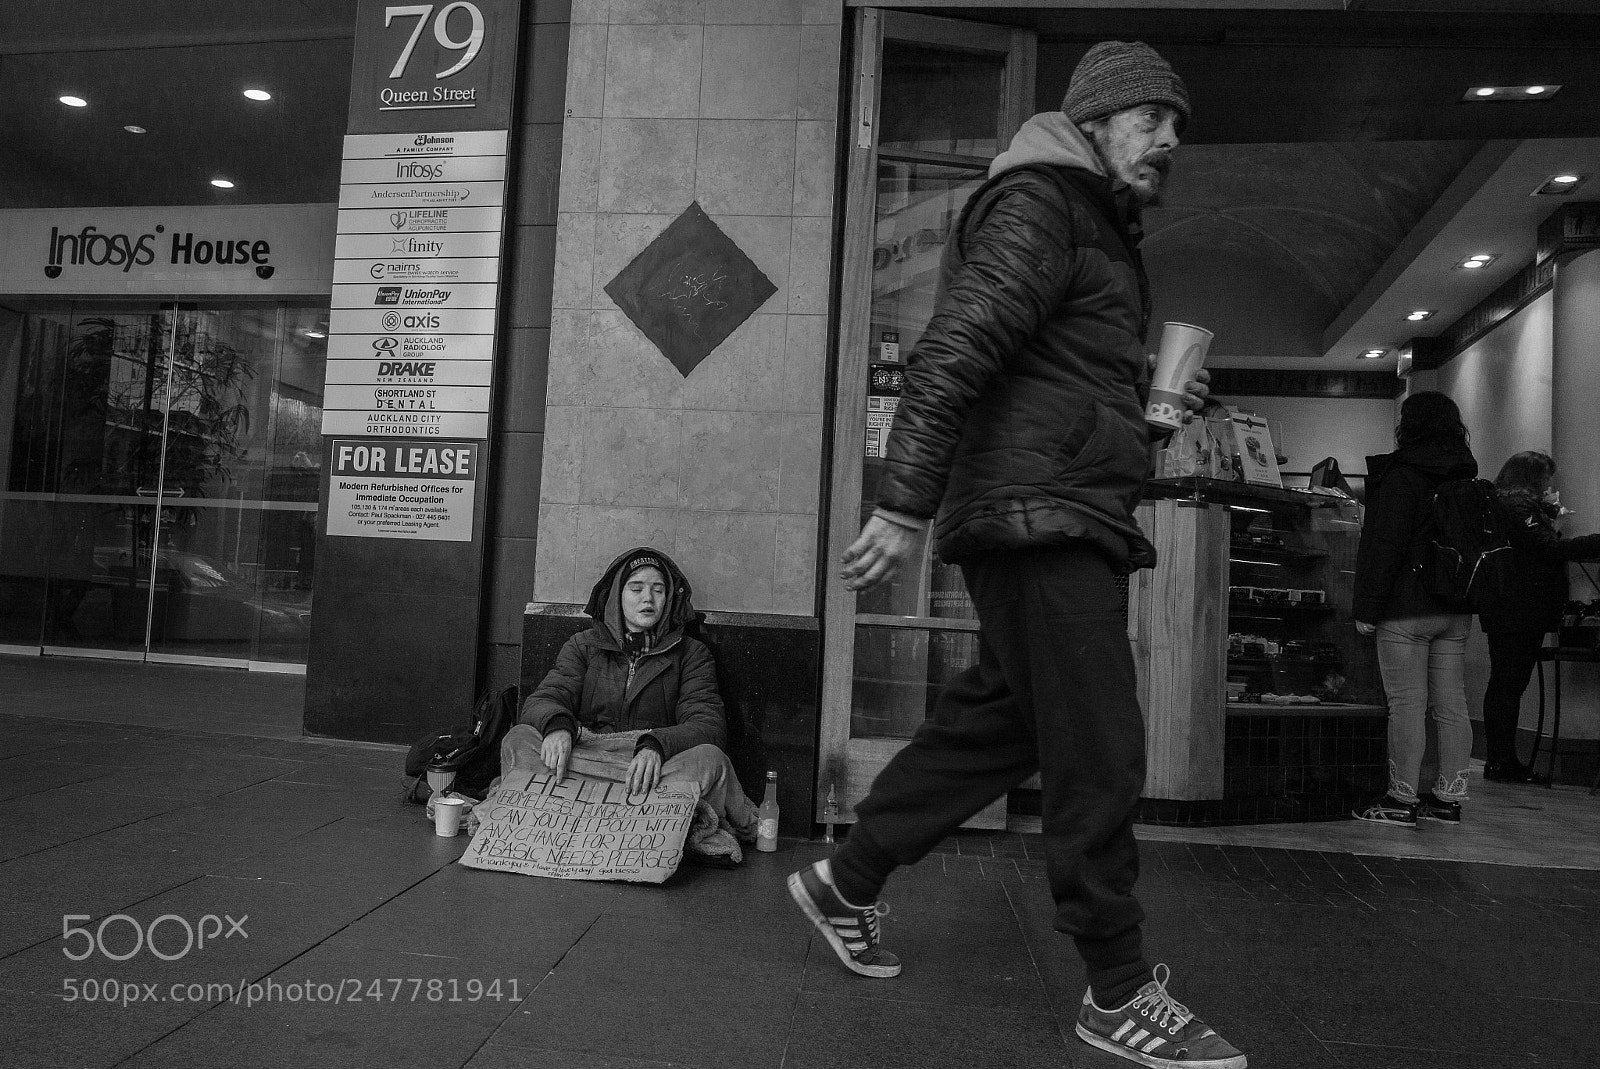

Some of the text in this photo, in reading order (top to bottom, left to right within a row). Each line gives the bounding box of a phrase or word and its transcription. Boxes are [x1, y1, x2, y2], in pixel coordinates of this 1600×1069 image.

[385, 1, 485, 80] 79
[380, 86, 477, 107] Queen Street
[396, 161, 443, 180] Infosys
[409, 210, 448, 219] LIFELINE
[49, 226, 271, 272] Infosys House
[408, 237, 444, 256] finity
[387, 262, 421, 272] nairns
[402, 298, 443, 306] International
[404, 289, 451, 301] UnionPay
[403, 312, 440, 328] axis
[377, 362, 436, 376] DRAKE
[377, 389, 437, 398] SHORTLAND ST
[376, 400, 436, 410] DENTAL
[367, 414, 442, 423] AUCKLAND CITY
[366, 426, 440, 434] ORTHODONTICS
[338, 446, 471, 475] FOR LEASE
[339, 482, 464, 494] Modern Refurbished Offices for
[355, 493, 445, 505] Immediate Occupation
[489, 806, 527, 826] CAN
[532, 811, 560, 829] YOU
[645, 816, 688, 833] WITH
[582, 833, 616, 850] FOR
[619, 832, 666, 850] FOOD
[488, 839, 543, 862] BASIC
[546, 849, 605, 867] NEEDS
